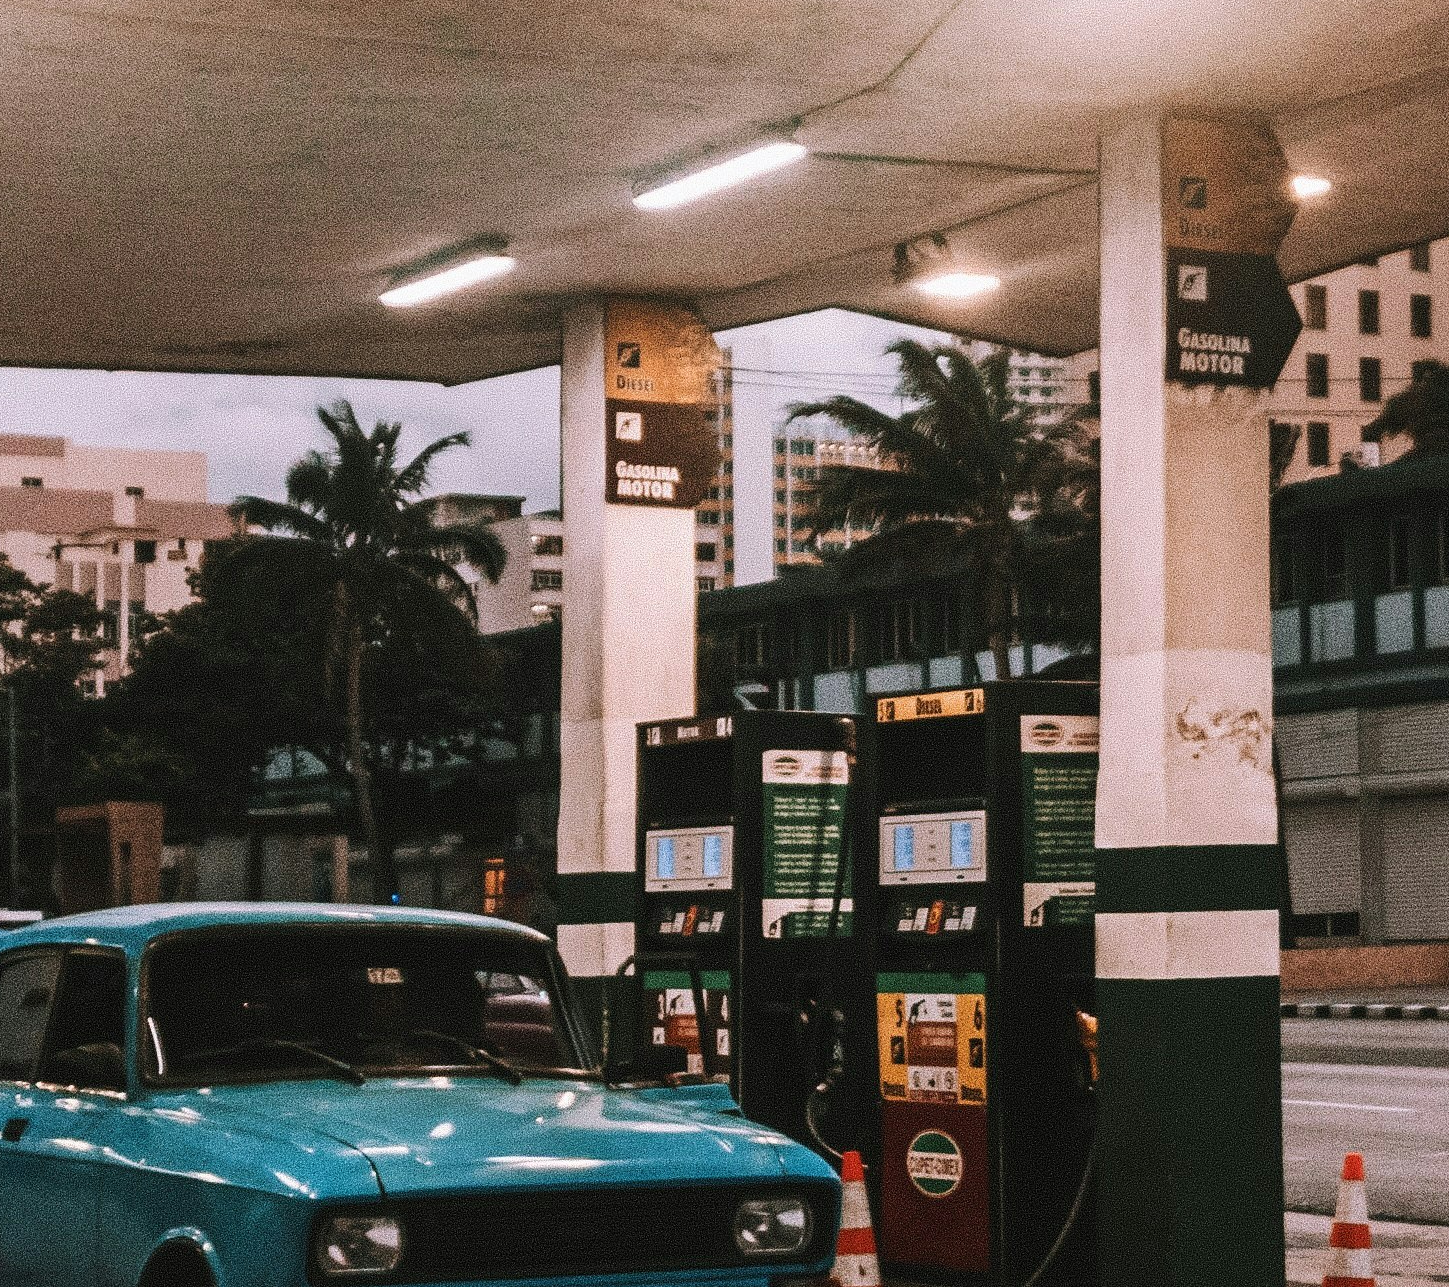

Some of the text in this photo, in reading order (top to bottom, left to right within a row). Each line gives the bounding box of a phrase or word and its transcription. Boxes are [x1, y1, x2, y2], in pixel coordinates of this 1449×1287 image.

[1177, 327, 1251, 354] GASOLINA
[1179, 351, 1245, 375] MOTOR
[617, 480, 674, 500] MOTOR
